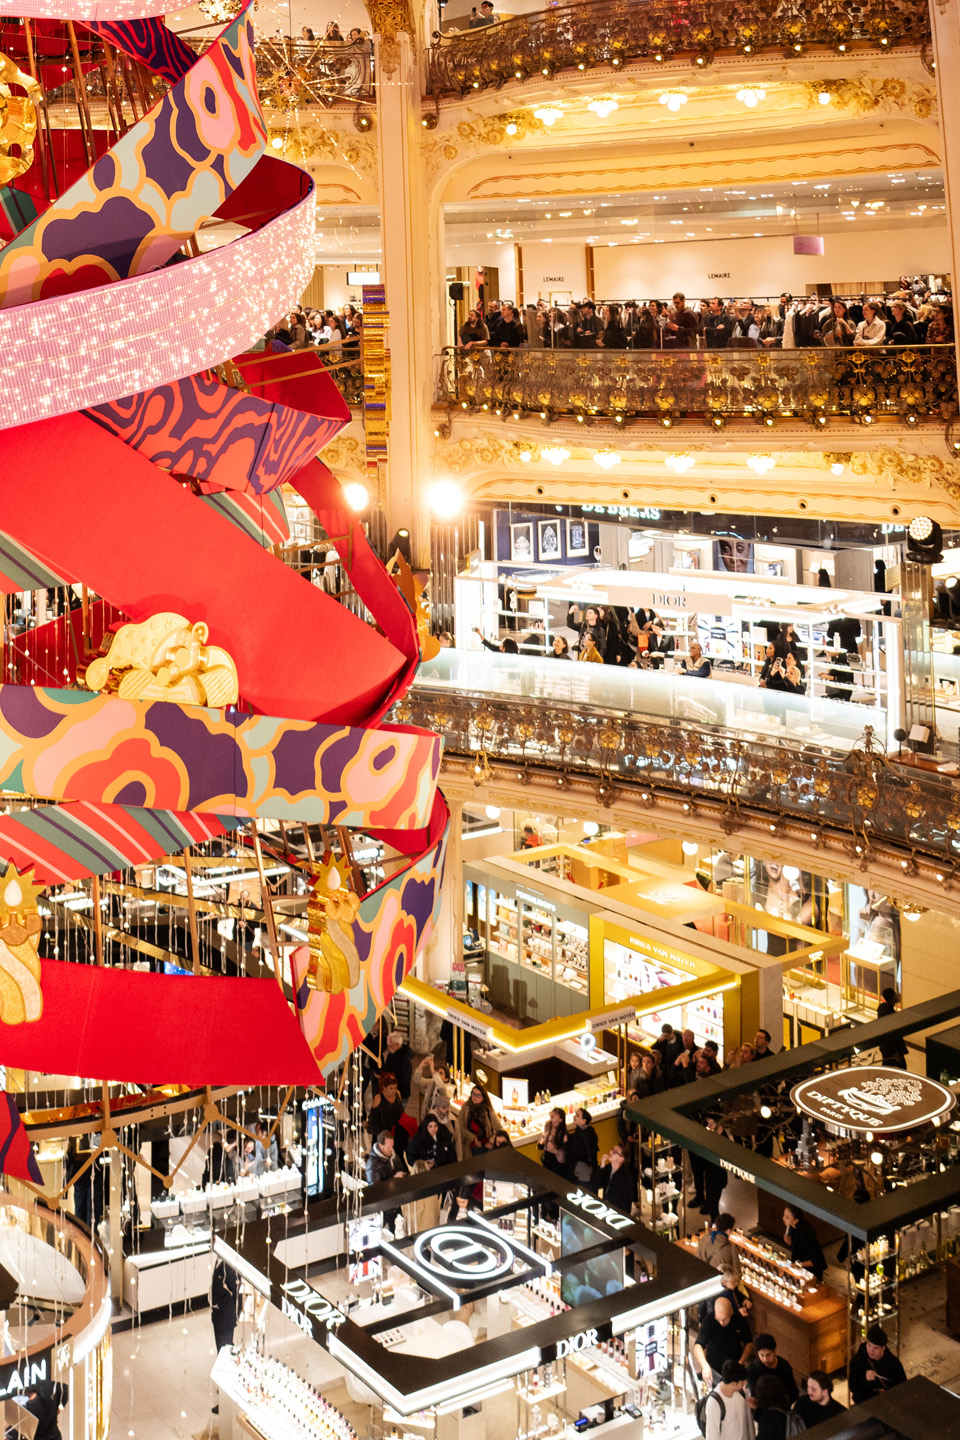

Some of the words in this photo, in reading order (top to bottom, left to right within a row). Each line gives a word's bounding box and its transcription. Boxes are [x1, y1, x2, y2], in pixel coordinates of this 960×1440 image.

[652, 593, 687, 608] DIOR
[806, 1090, 884, 1127] DIPTYQUE
[819, 1106, 845, 1120] PARIS
[719, 1158, 756, 1184] DIPTYQUE
[566, 1188, 636, 1230] DIOR
[280, 1278, 346, 1330] DIOR
[281, 1296, 314, 1339] DIOR
[556, 1328, 599, 1360] DIOR
